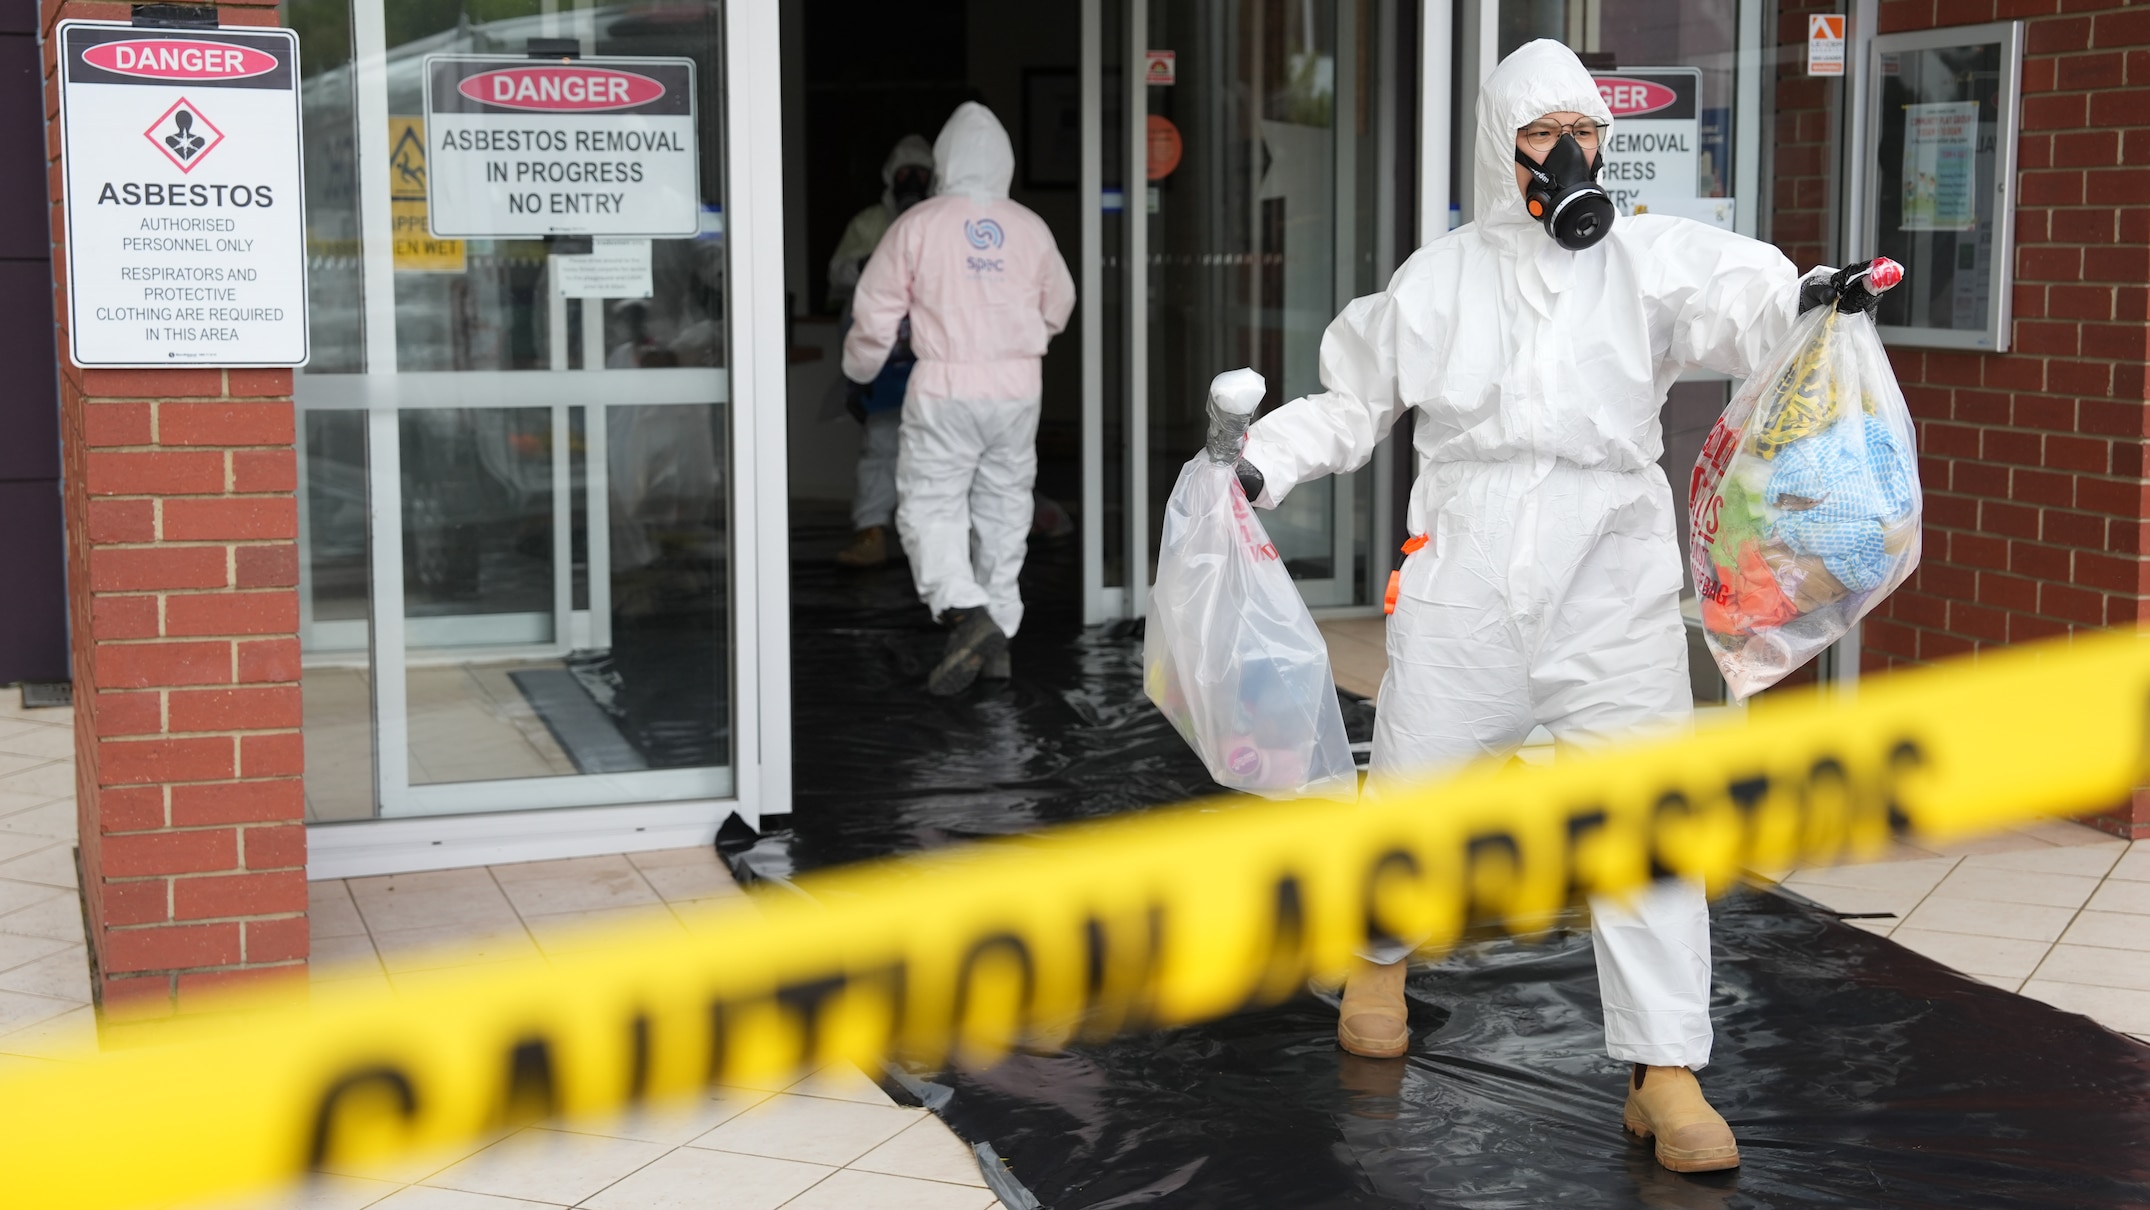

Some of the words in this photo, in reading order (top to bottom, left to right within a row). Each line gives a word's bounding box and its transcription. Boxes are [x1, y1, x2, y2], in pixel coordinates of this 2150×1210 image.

[115, 46, 246, 73] DANGER
[493, 75, 630, 102] DANGER
[1597, 85, 1649, 109] GER
[441, 129, 568, 152] ASBESTOS
[575, 130, 686, 152] REMOVAL
[485, 161, 509, 183] IN
[516, 161, 644, 184] PROGRESS
[98, 181, 274, 208] ASBESTOS
[508, 192, 543, 214] NO
[549, 192, 625, 215] ENTRY
[1606, 189, 1640, 208] TRY
[139, 217, 236, 233] AUTHORISED
[122, 237, 213, 252] PERSONNEL
[216, 238, 254, 253] ONLY
[394, 239, 419, 256] EN
[425, 239, 457, 256] WET
[121, 267, 225, 282] RESPIRATORS
[227, 268, 258, 282] AND
[144, 287, 237, 302] PROTECTIVE
[96, 307, 172, 322] CLOTHING
[175, 308, 205, 321] ARE
[209, 308, 284, 323] REQUIRED
[145, 328, 160, 341] IN
[163, 328, 197, 341] THIS
[200, 328, 240, 342] AREA
[1702, 576, 1729, 606] BAG
